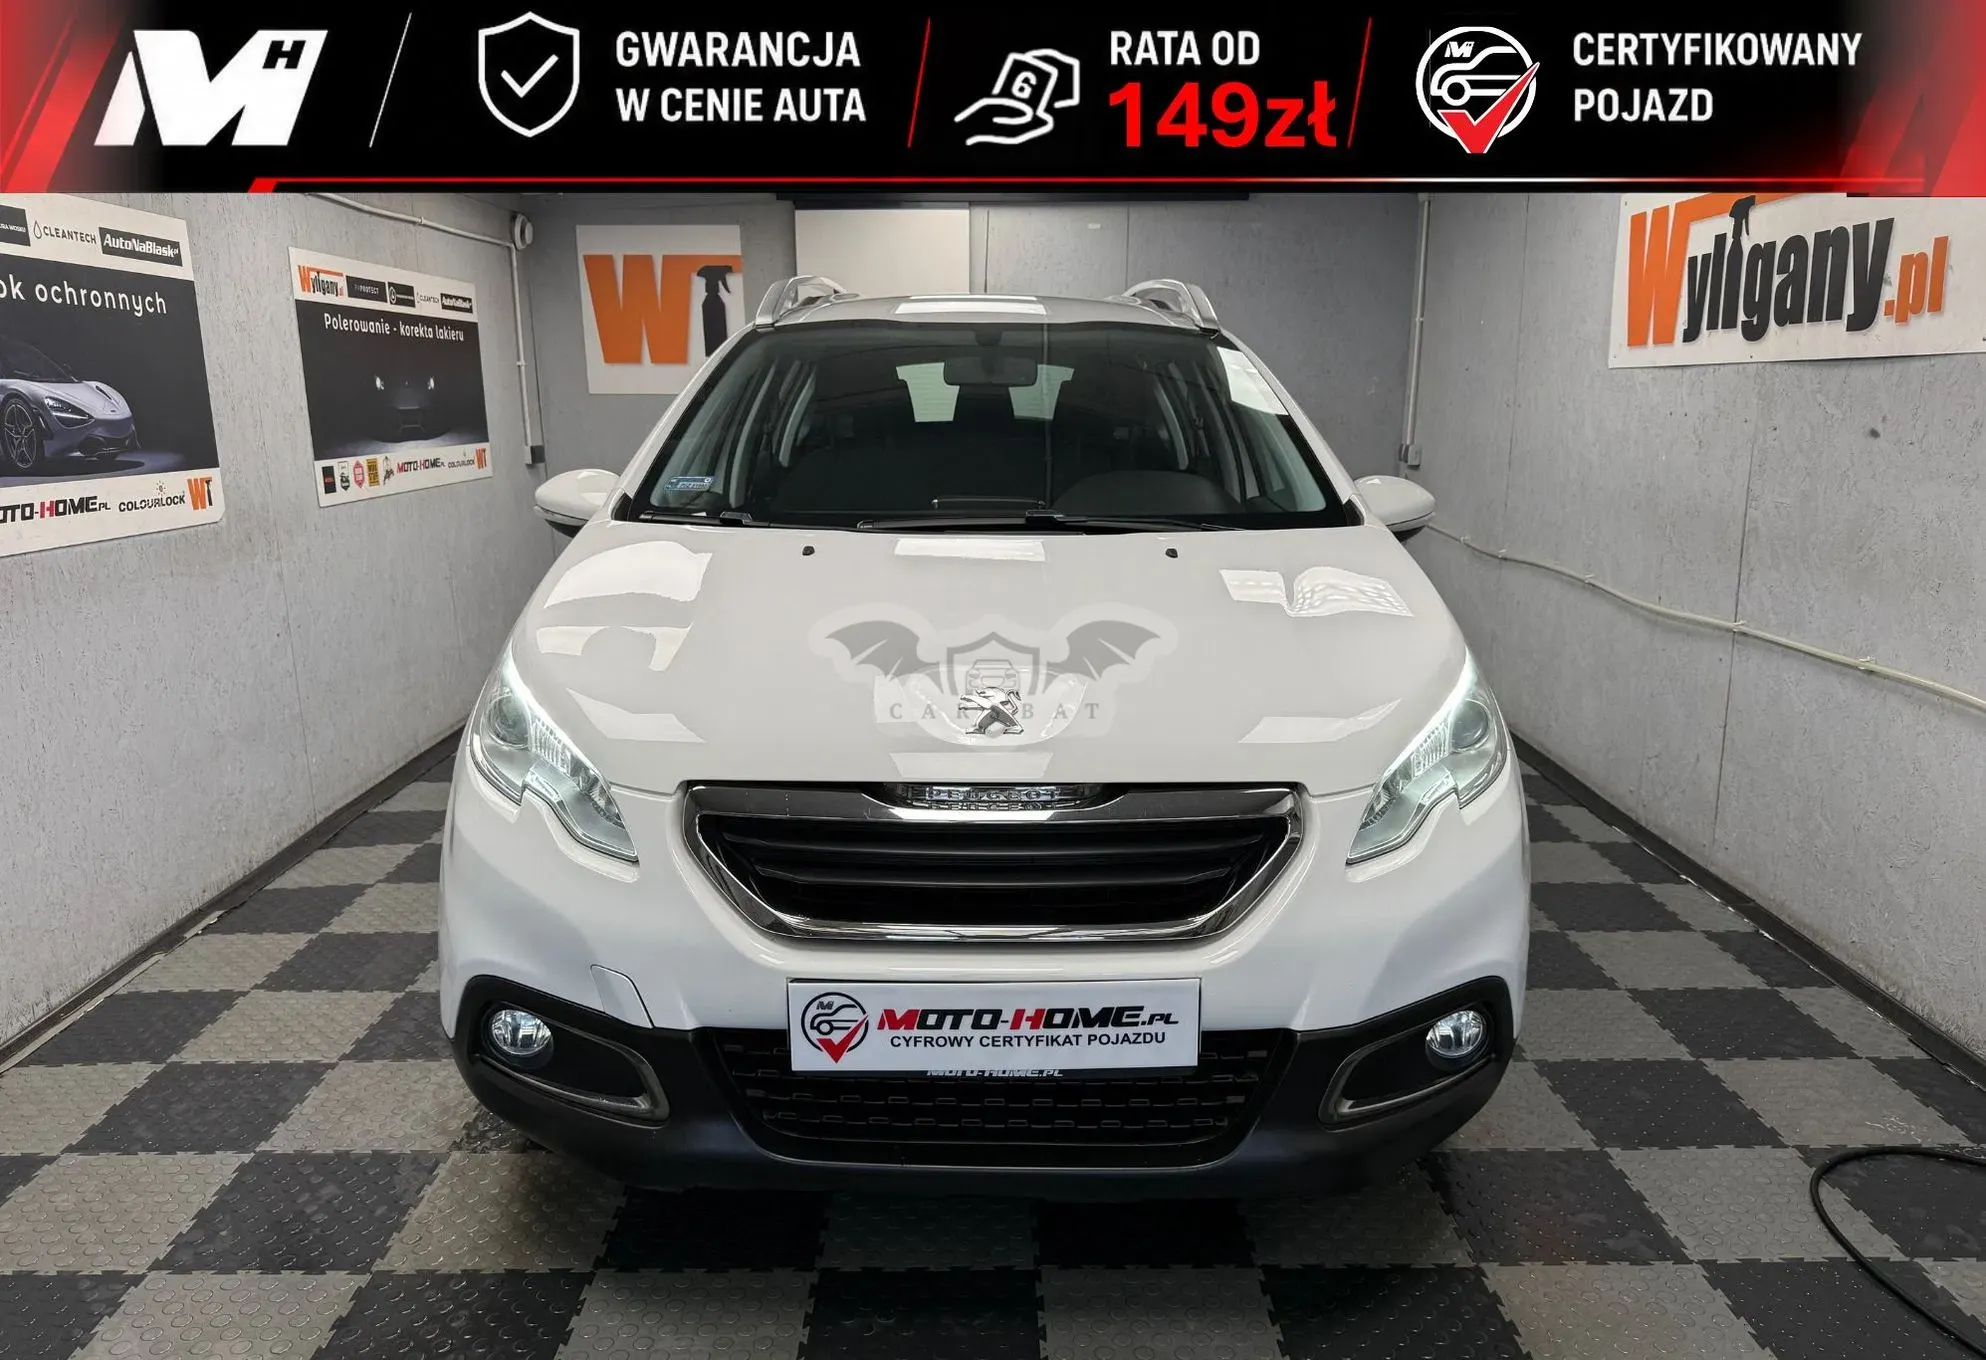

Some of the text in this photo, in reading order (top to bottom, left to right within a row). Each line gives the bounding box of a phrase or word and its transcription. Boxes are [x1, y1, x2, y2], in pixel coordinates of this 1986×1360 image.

[43, 225, 97, 245] CLEANTECH
[35, 280, 168, 318] ochronnych
[324, 313, 391, 335] Polerowanie
[400, 321, 434, 339] korekta
[435, 325, 465, 342] lakieru
[119, 493, 186, 513] COLOURLOCK
[877, 1005, 1180, 1031] MOTO-HOME.PL
[890, 1032, 1166, 1048] CYFROWY CERTYFIKAT POJAZDU
